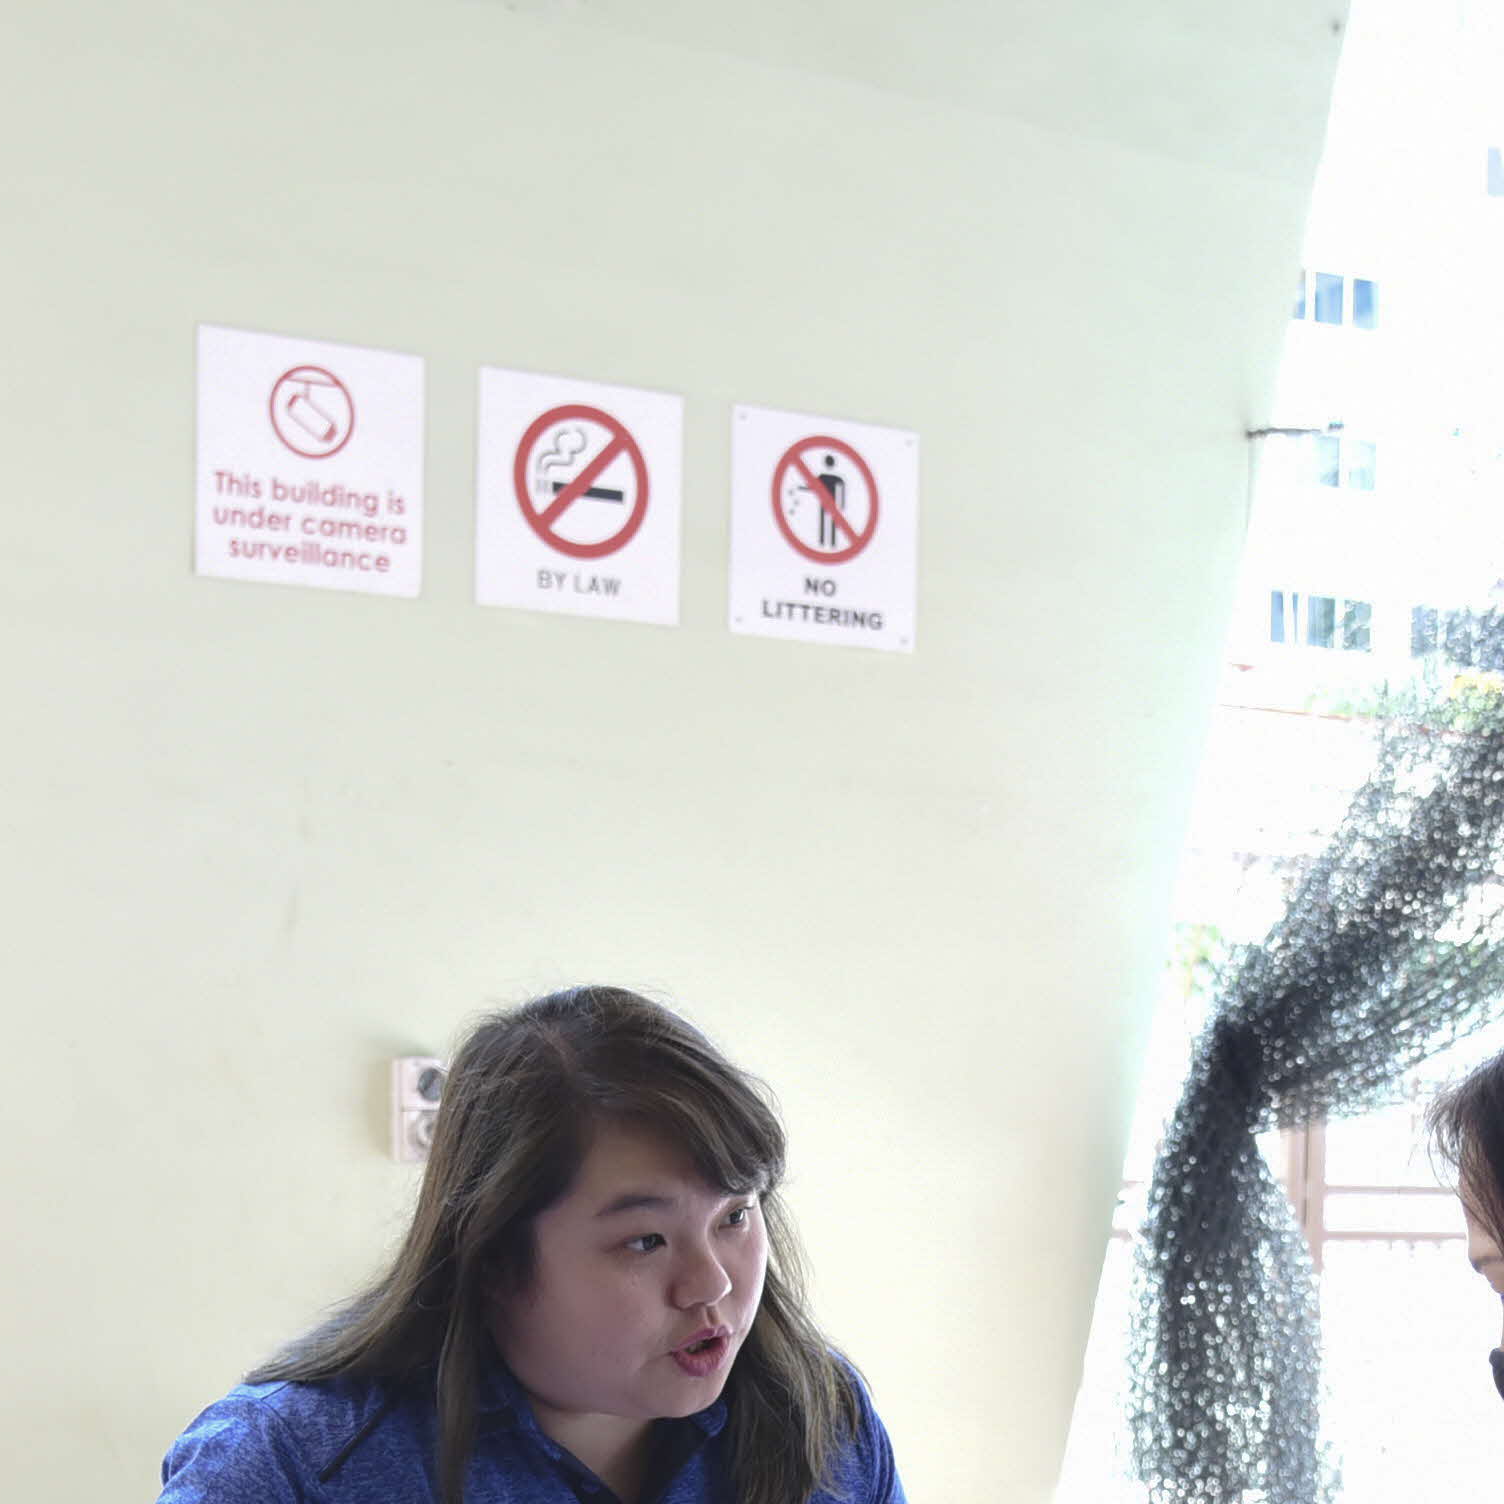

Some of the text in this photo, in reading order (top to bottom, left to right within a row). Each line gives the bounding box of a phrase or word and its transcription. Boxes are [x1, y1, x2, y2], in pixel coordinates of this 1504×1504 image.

[213, 471, 406, 515] This building is
[212, 505, 406, 545] under camera
[229, 535, 390, 573] surveillance
[537, 569, 621, 598] BY LAW
[805, 577, 837, 598] NO
[762, 600, 884, 631] LITTERING
